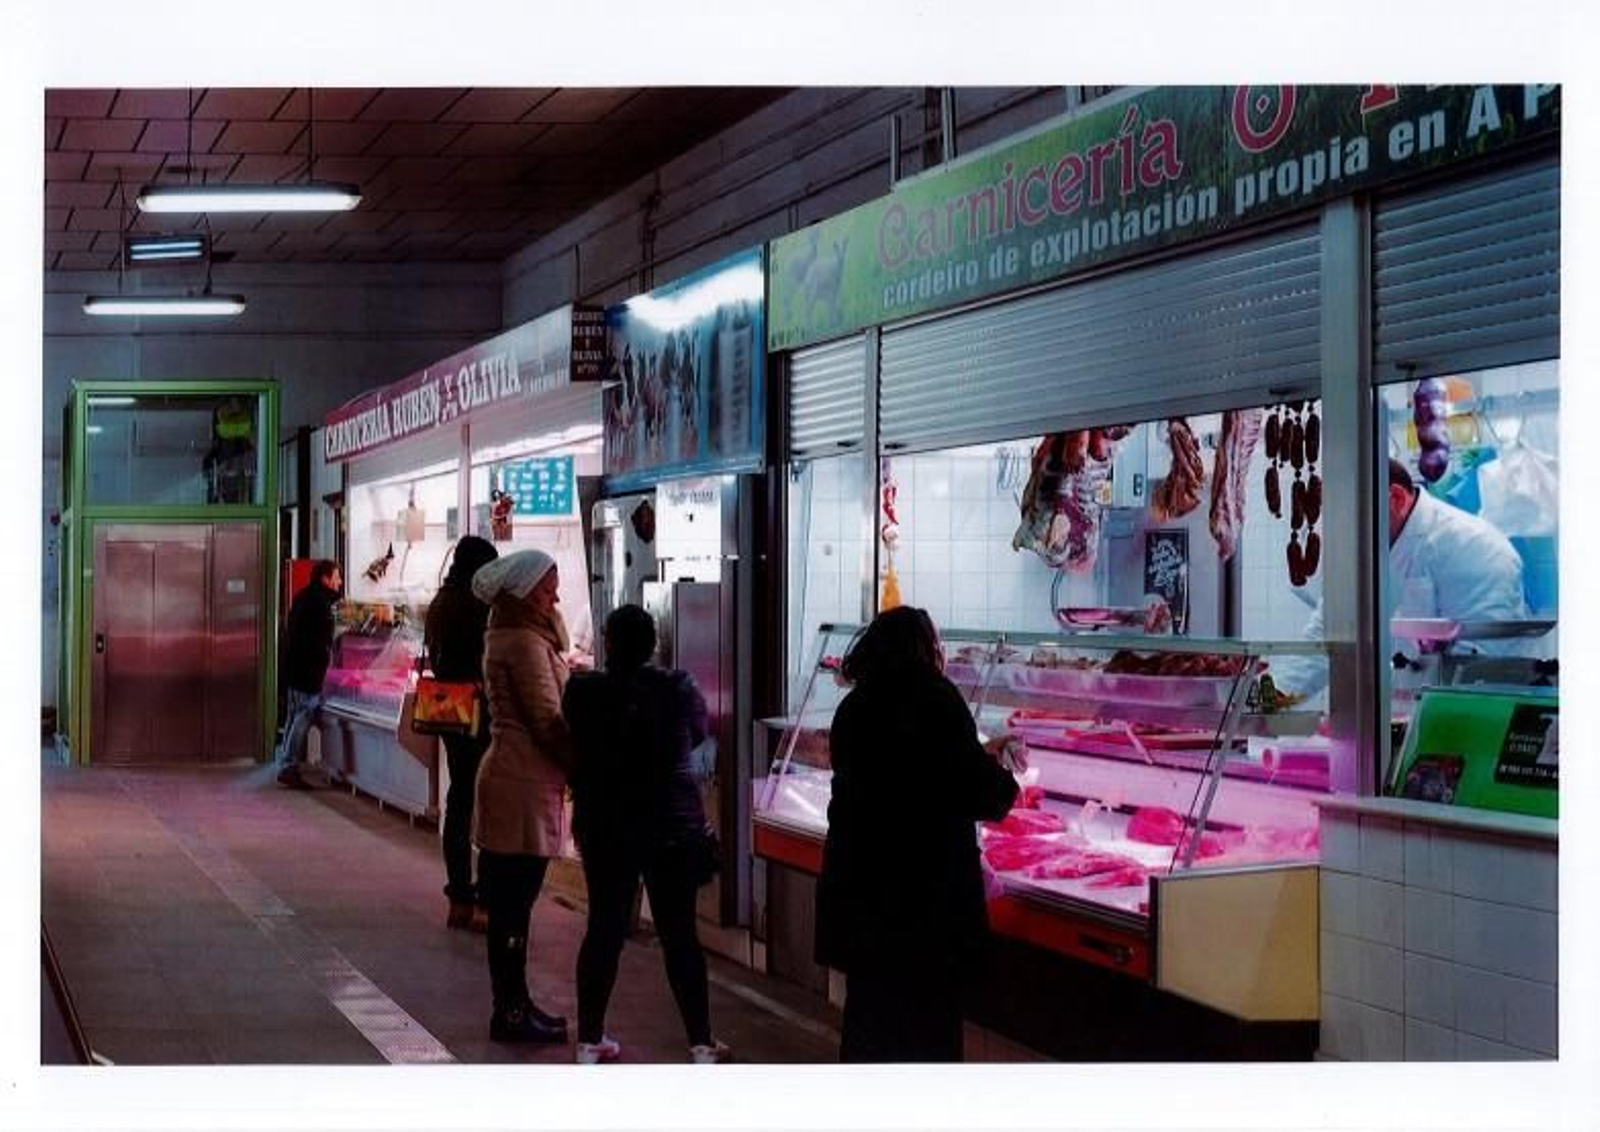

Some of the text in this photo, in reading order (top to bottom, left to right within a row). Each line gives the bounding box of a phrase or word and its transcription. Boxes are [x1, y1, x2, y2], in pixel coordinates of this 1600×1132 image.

[879, 106, 1183, 267] Carnicería
[882, 263, 979, 308] cordeiro
[988, 243, 1018, 279] de
[1031, 185, 1218, 263] explotación
[1234, 137, 1370, 216] propia
[1389, 109, 1446, 162] en
[1466, 85, 1501, 139] A
[326, 392, 391, 457] CARNICERÍA
[393, 370, 442, 435] RUBÉN
[458, 354, 521, 410] OLIVIA
